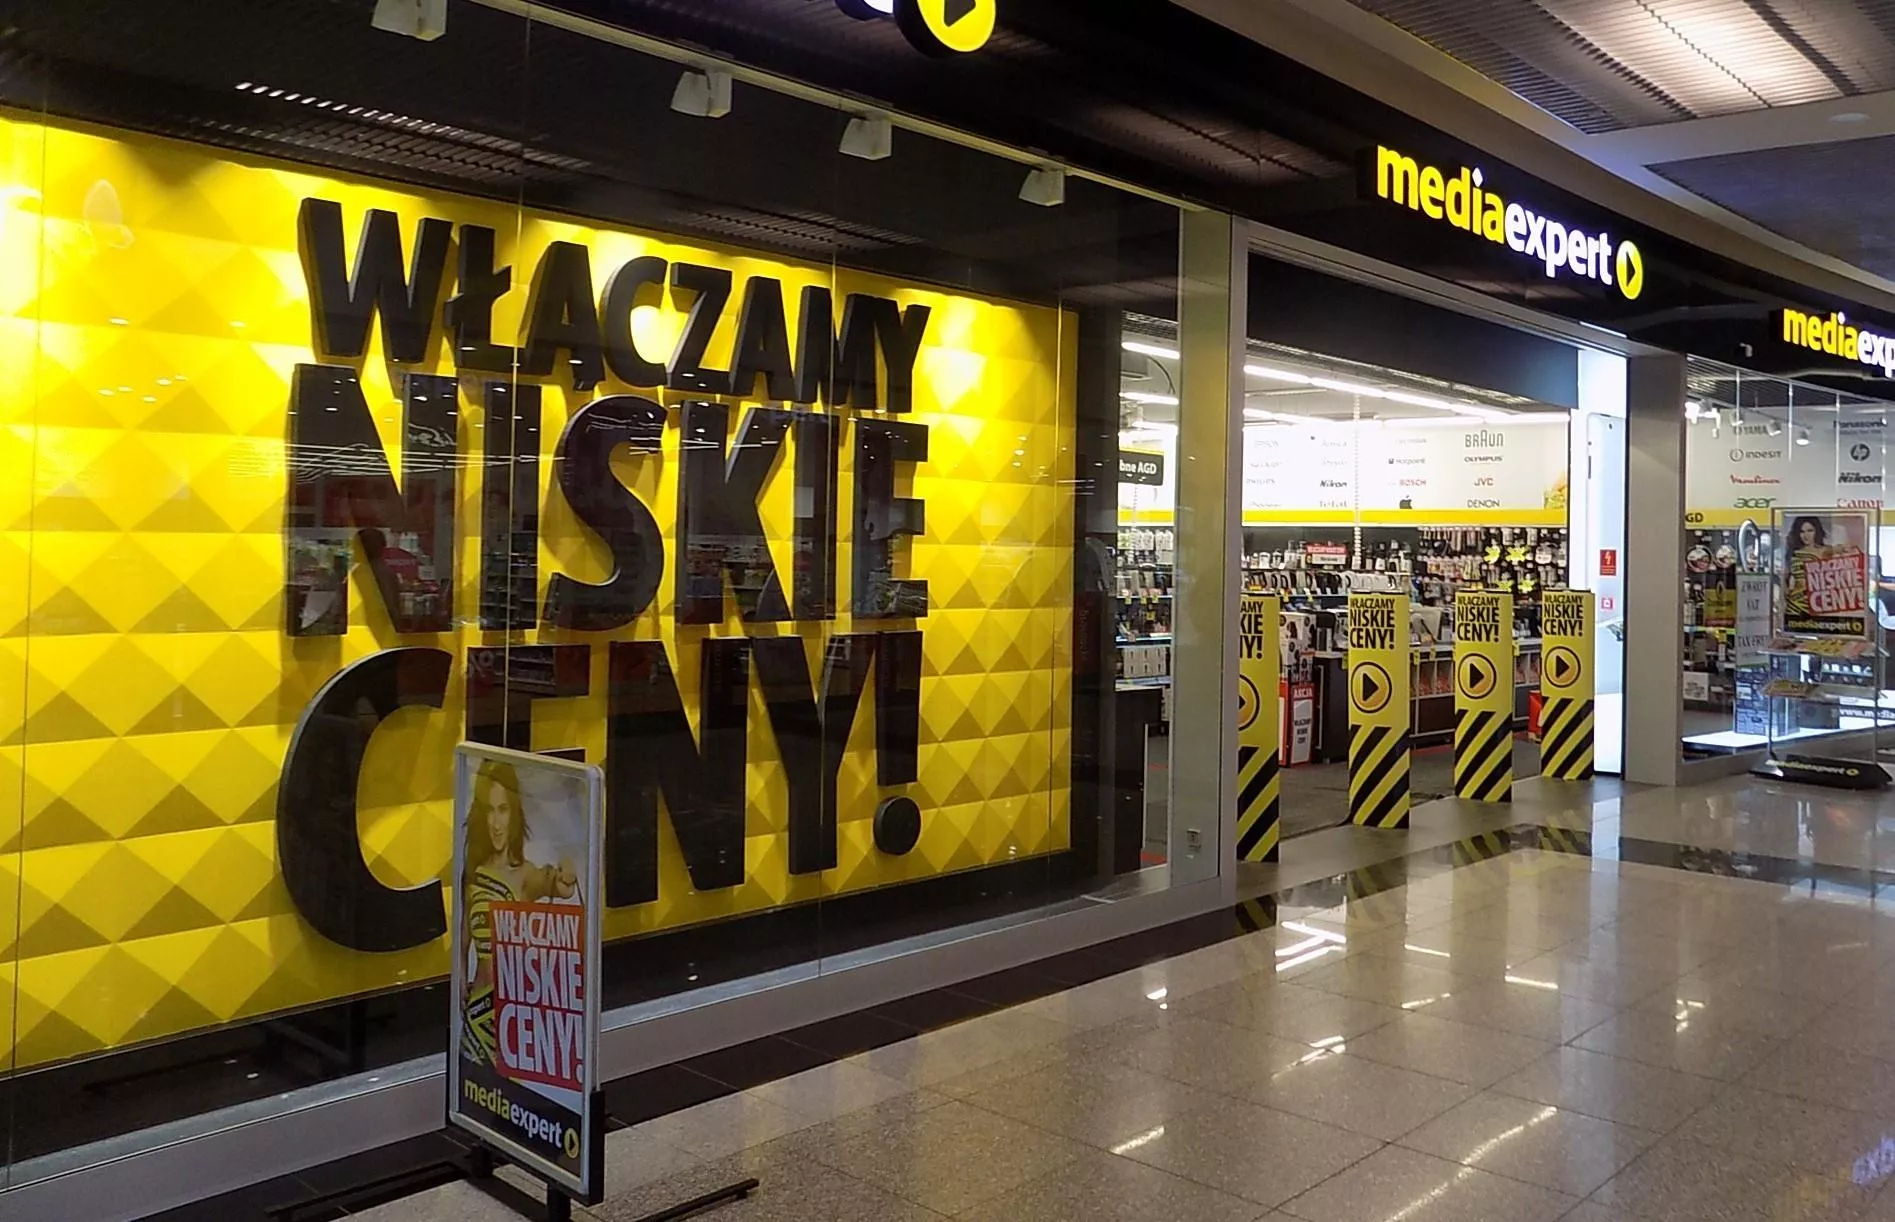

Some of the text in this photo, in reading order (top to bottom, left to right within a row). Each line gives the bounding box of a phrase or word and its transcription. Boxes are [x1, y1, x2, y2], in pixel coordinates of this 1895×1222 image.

[1377, 145, 1612, 285] mediaexpert
[297, 197, 931, 412] WŁĄCZAMY
[1465, 430, 1504, 448] BRAUN
[1137, 461, 1157, 475] AGD
[1320, 480, 1347, 488] Nikon
[1474, 477, 1494, 487] JVC
[280, 363, 930, 637] NISKIE
[1467, 499, 1500, 508] DENON
[1734, 497, 1776, 509] acer
[1808, 568, 1864, 592] NISKIE
[1809, 587, 1865, 613] CENY!
[1350, 609, 1395, 628] NISKIE
[1457, 606, 1500, 623] NISKIE
[1544, 603, 1584, 619] NISKIE
[1457, 622, 1500, 643] CENY!
[1544, 618, 1583, 637] CENY!
[1350, 627, 1395, 650] CENY!
[494, 909, 580, 950] WŁĄCZAMY
[496, 943, 584, 1012] NISKIE
[500, 1002, 585, 1084] CENY!
[464, 1078, 563, 1149] mediaexpert
